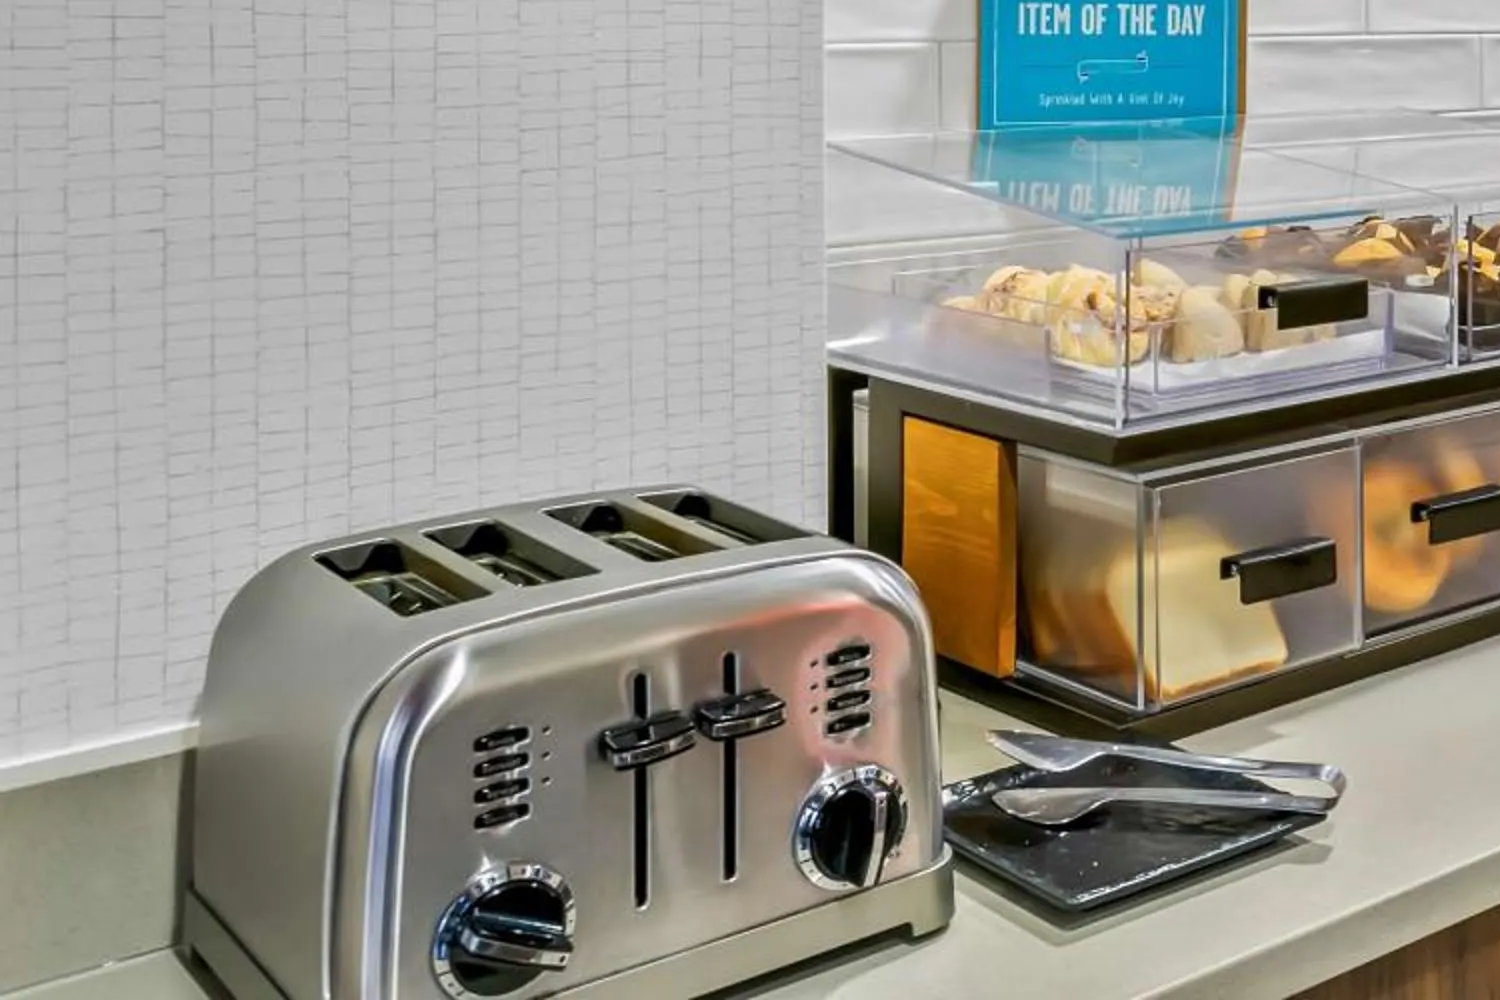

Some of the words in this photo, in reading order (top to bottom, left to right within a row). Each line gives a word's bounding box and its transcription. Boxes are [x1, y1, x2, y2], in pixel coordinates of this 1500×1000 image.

[1018, 2, 1071, 36] ITEM
[1081, 3, 1109, 36] OF
[1116, 3, 1157, 36] THE
[1167, 4, 1206, 36] DAY
